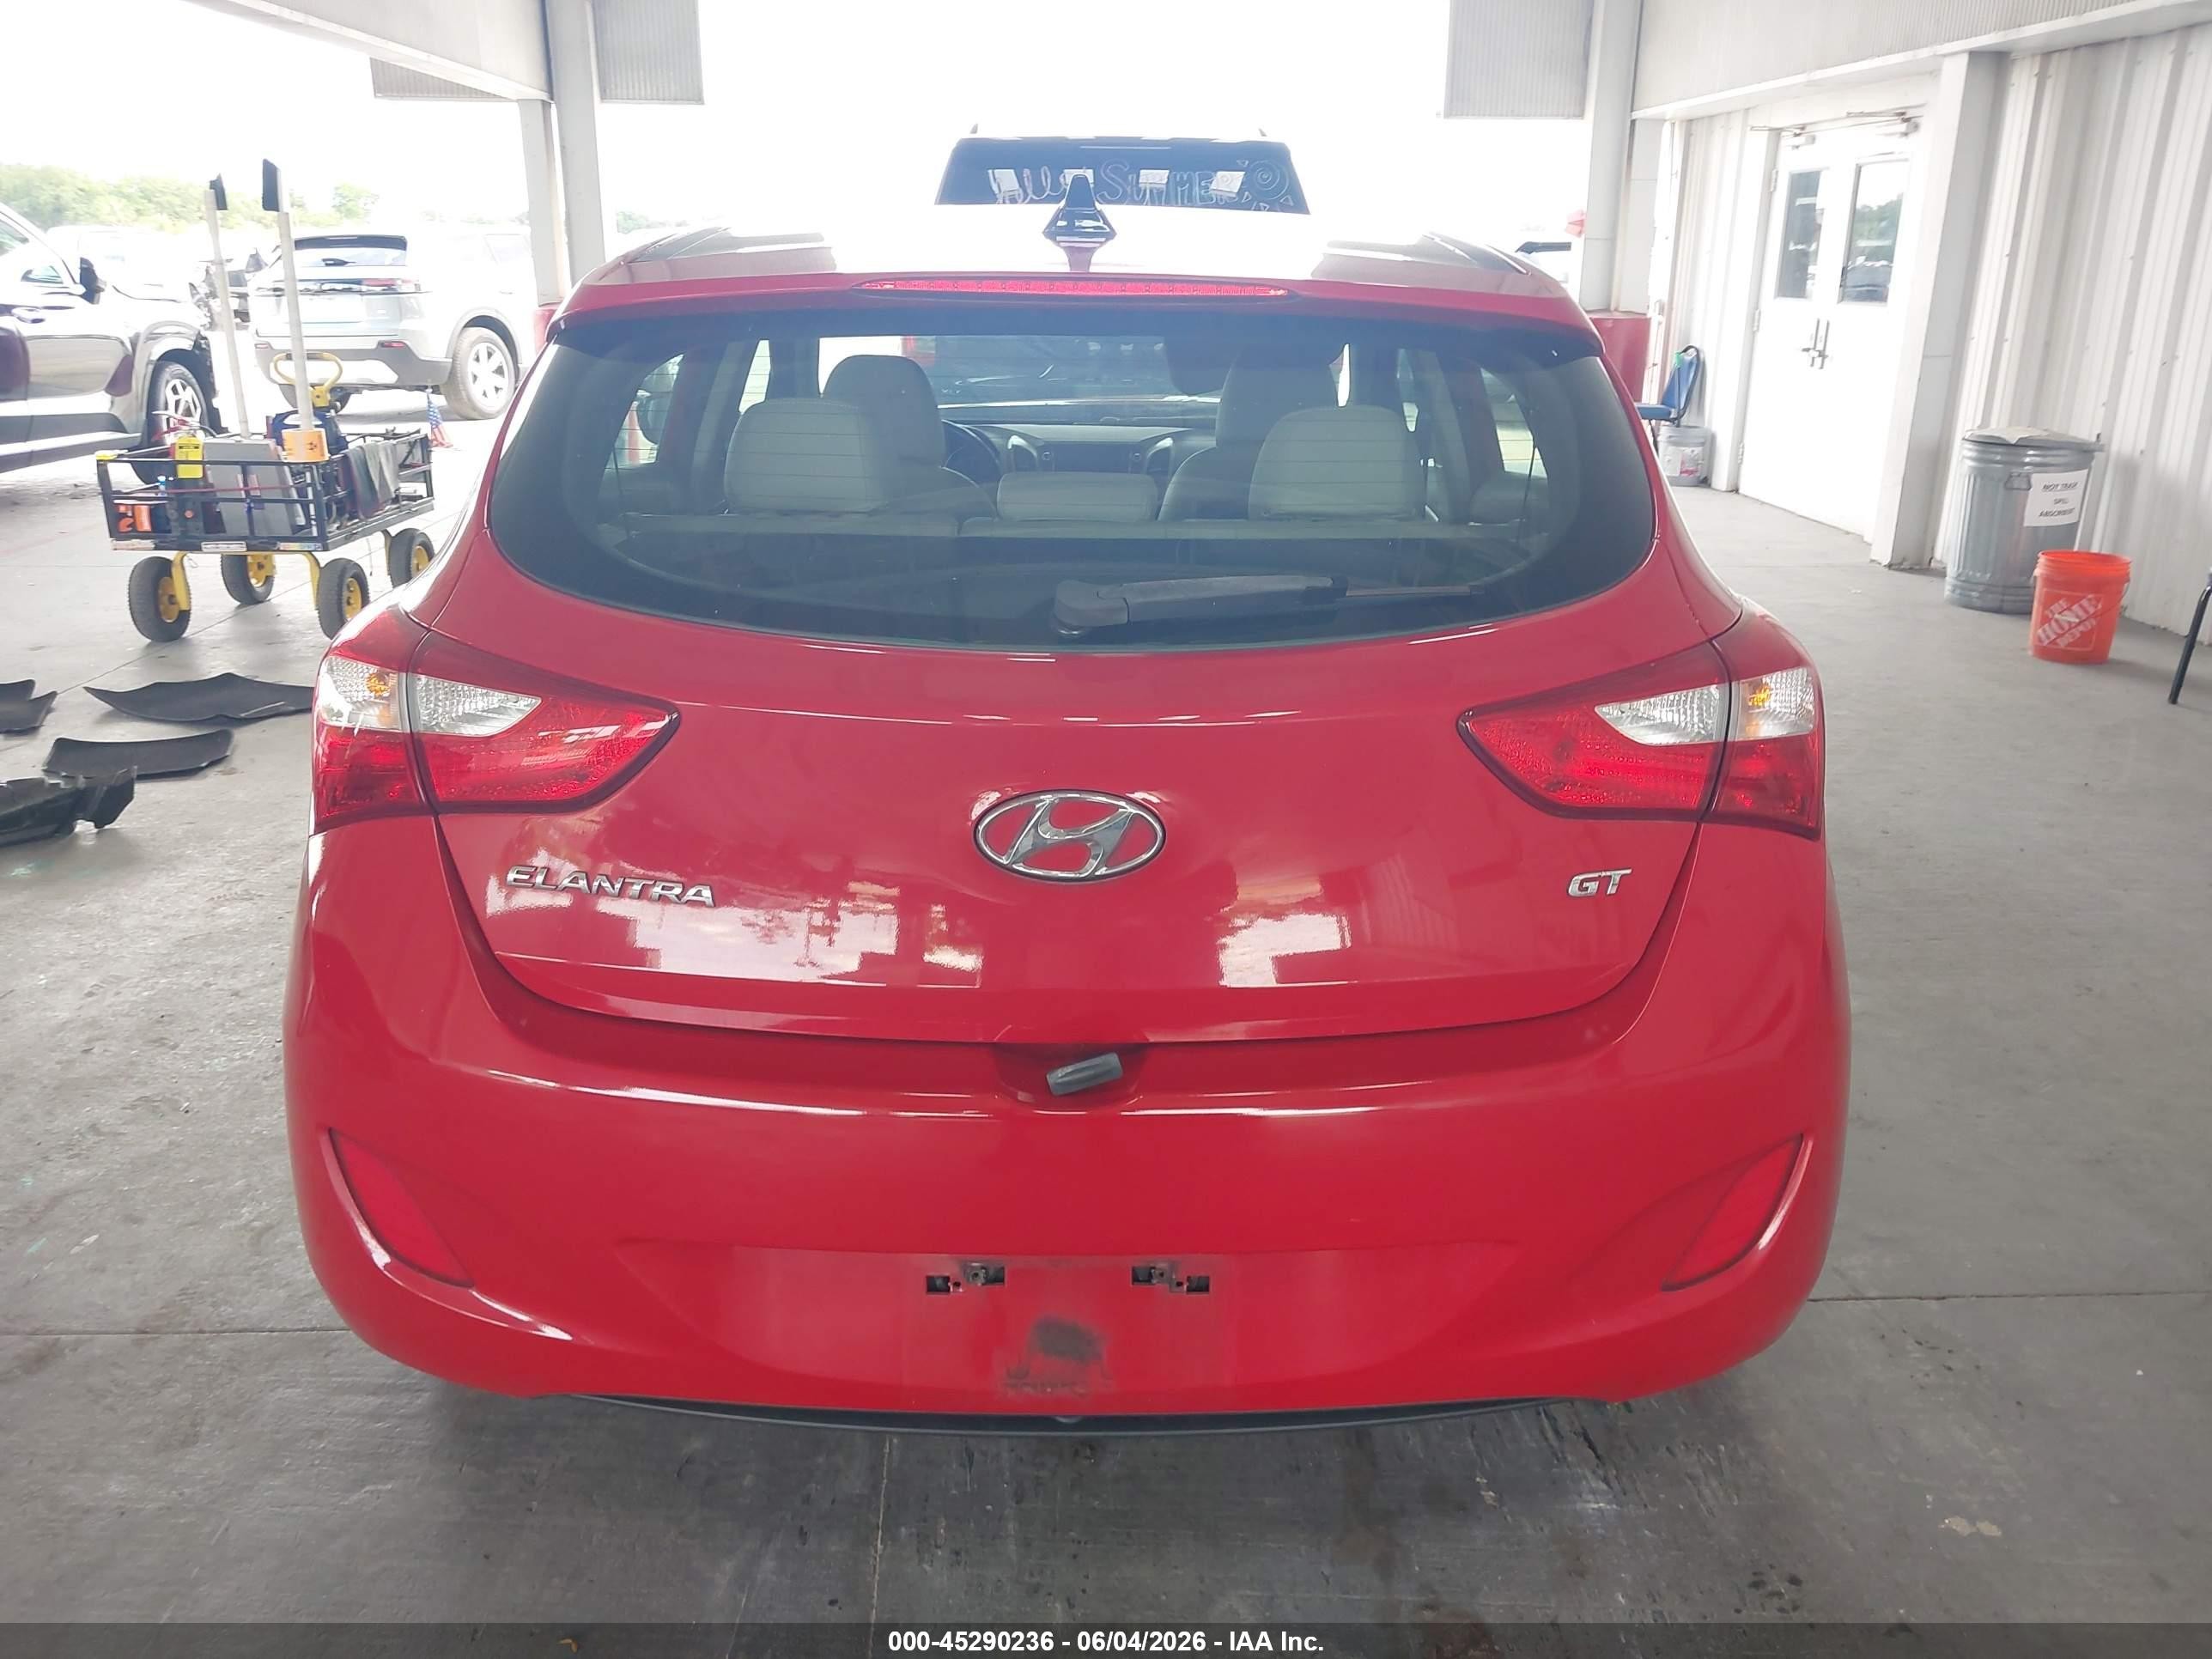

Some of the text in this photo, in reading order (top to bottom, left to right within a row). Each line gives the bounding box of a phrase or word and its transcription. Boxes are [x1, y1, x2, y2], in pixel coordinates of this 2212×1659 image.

[2038, 594, 2102, 647] HOME
[2056, 617, 2098, 647] DEPOT
[506, 865, 715, 907] ELANTRA
[1567, 867, 1632, 897] GT
